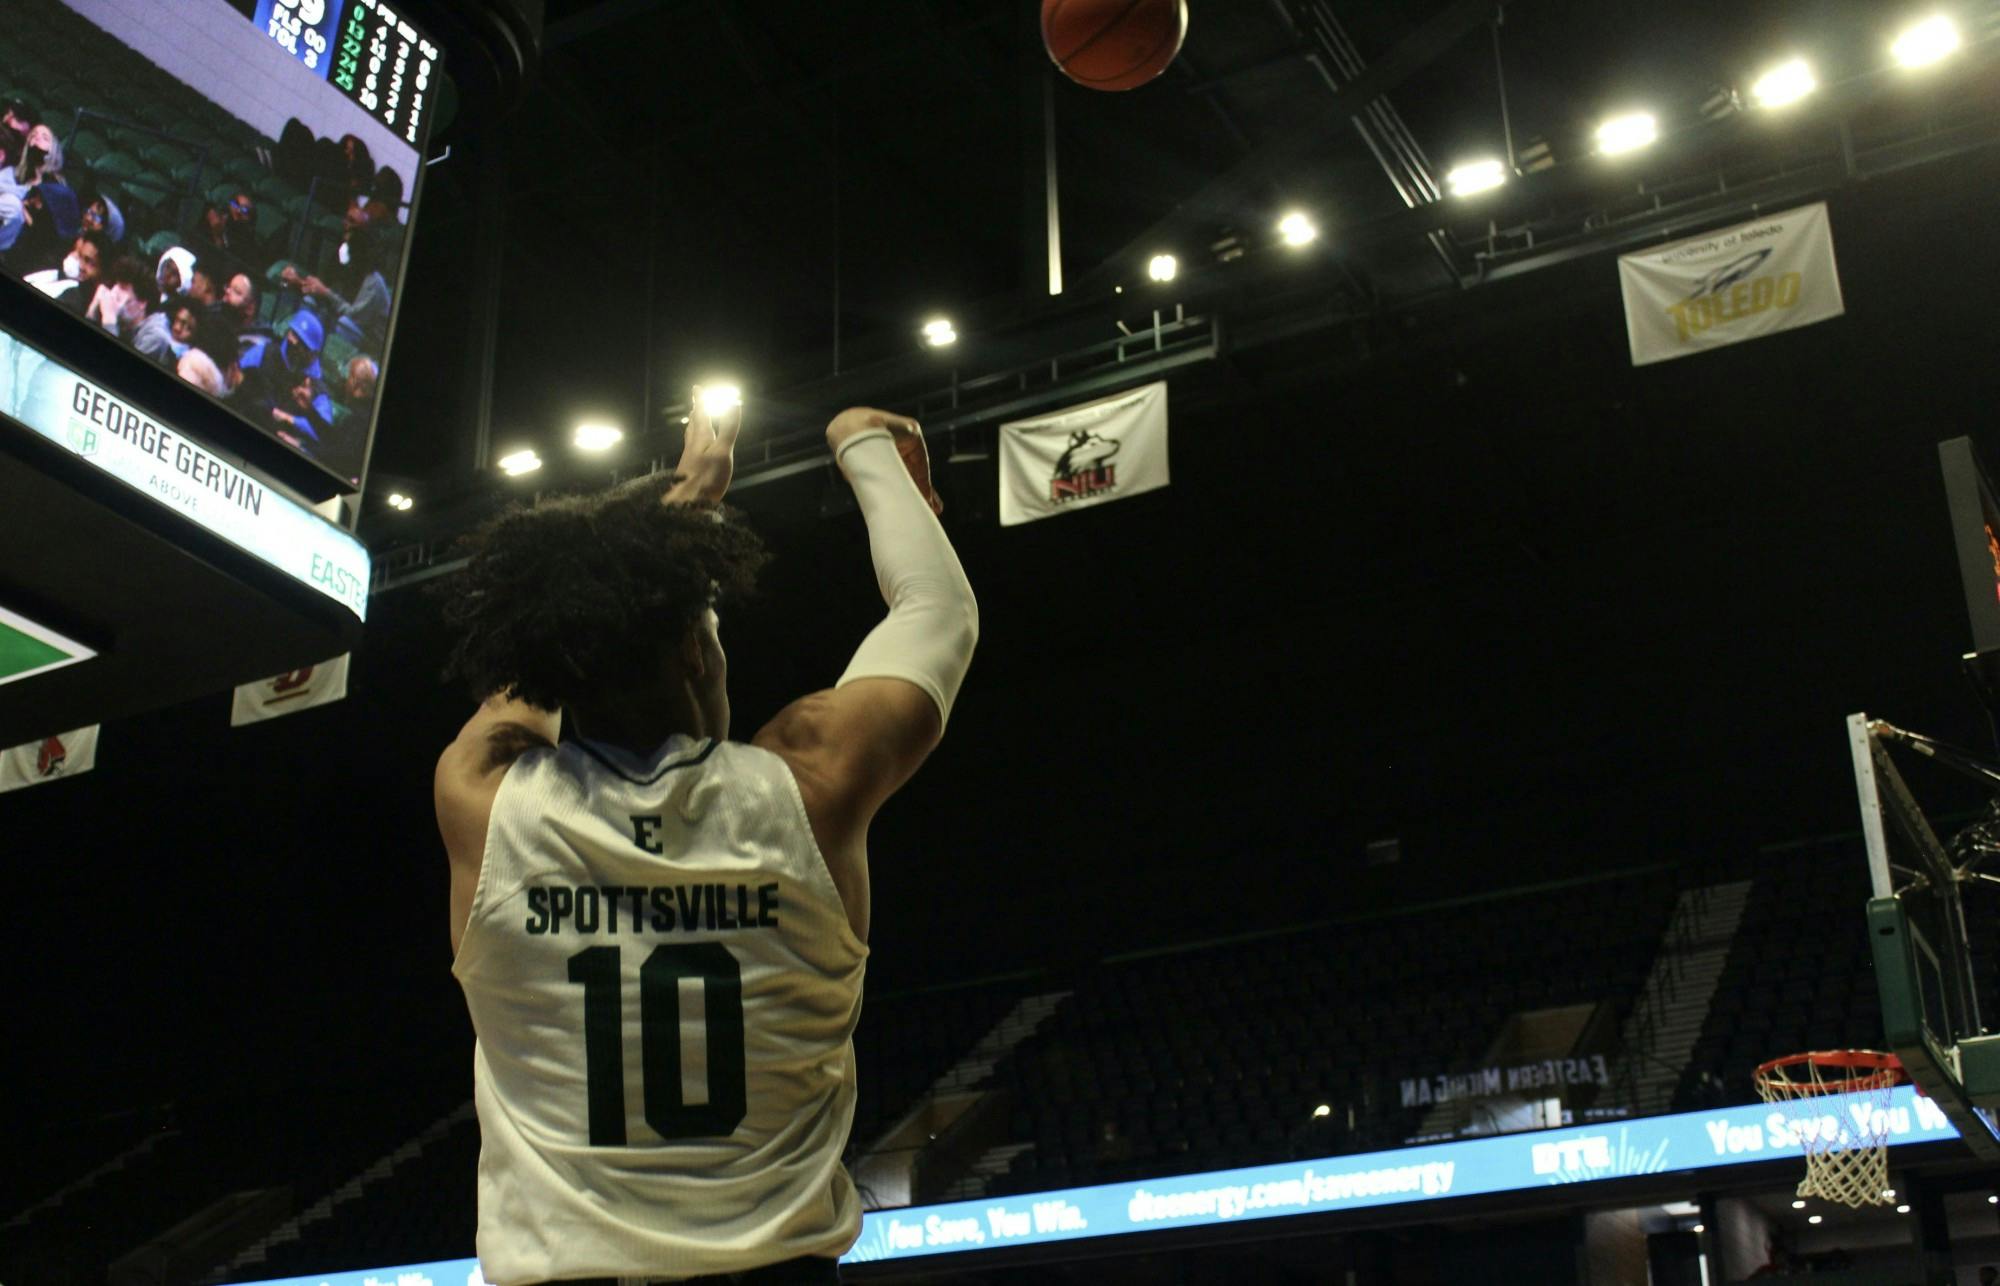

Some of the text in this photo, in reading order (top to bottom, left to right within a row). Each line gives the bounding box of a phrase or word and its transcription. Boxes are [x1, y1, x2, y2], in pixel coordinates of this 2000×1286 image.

[347, 19, 365, 41] 13
[353, 5, 365, 21] 0
[338, 51, 357, 74] 24
[409, 109, 419, 127] 1
[342, 34, 362, 58] 22
[412, 93, 423, 111] 1
[335, 68, 354, 91] 25
[406, 125, 416, 143] 1
[1665, 271, 1801, 343] TOLEDO
[73, 382, 262, 516] GEORGE GERVIN
[149, 474, 198, 511] ABOVE
[1049, 464, 1116, 502] NIU
[629, 814, 664, 856] E
[525, 882, 779, 935] SPOTTSVILLE
[567, 941, 748, 1147] 10
[1704, 1118, 1764, 1155] You
[1766, 1112, 1848, 1149] Save,
[1849, 1102, 1911, 1138] You
[987, 1205, 1031, 1239] You
[1033, 1199, 1088, 1234] Win.
